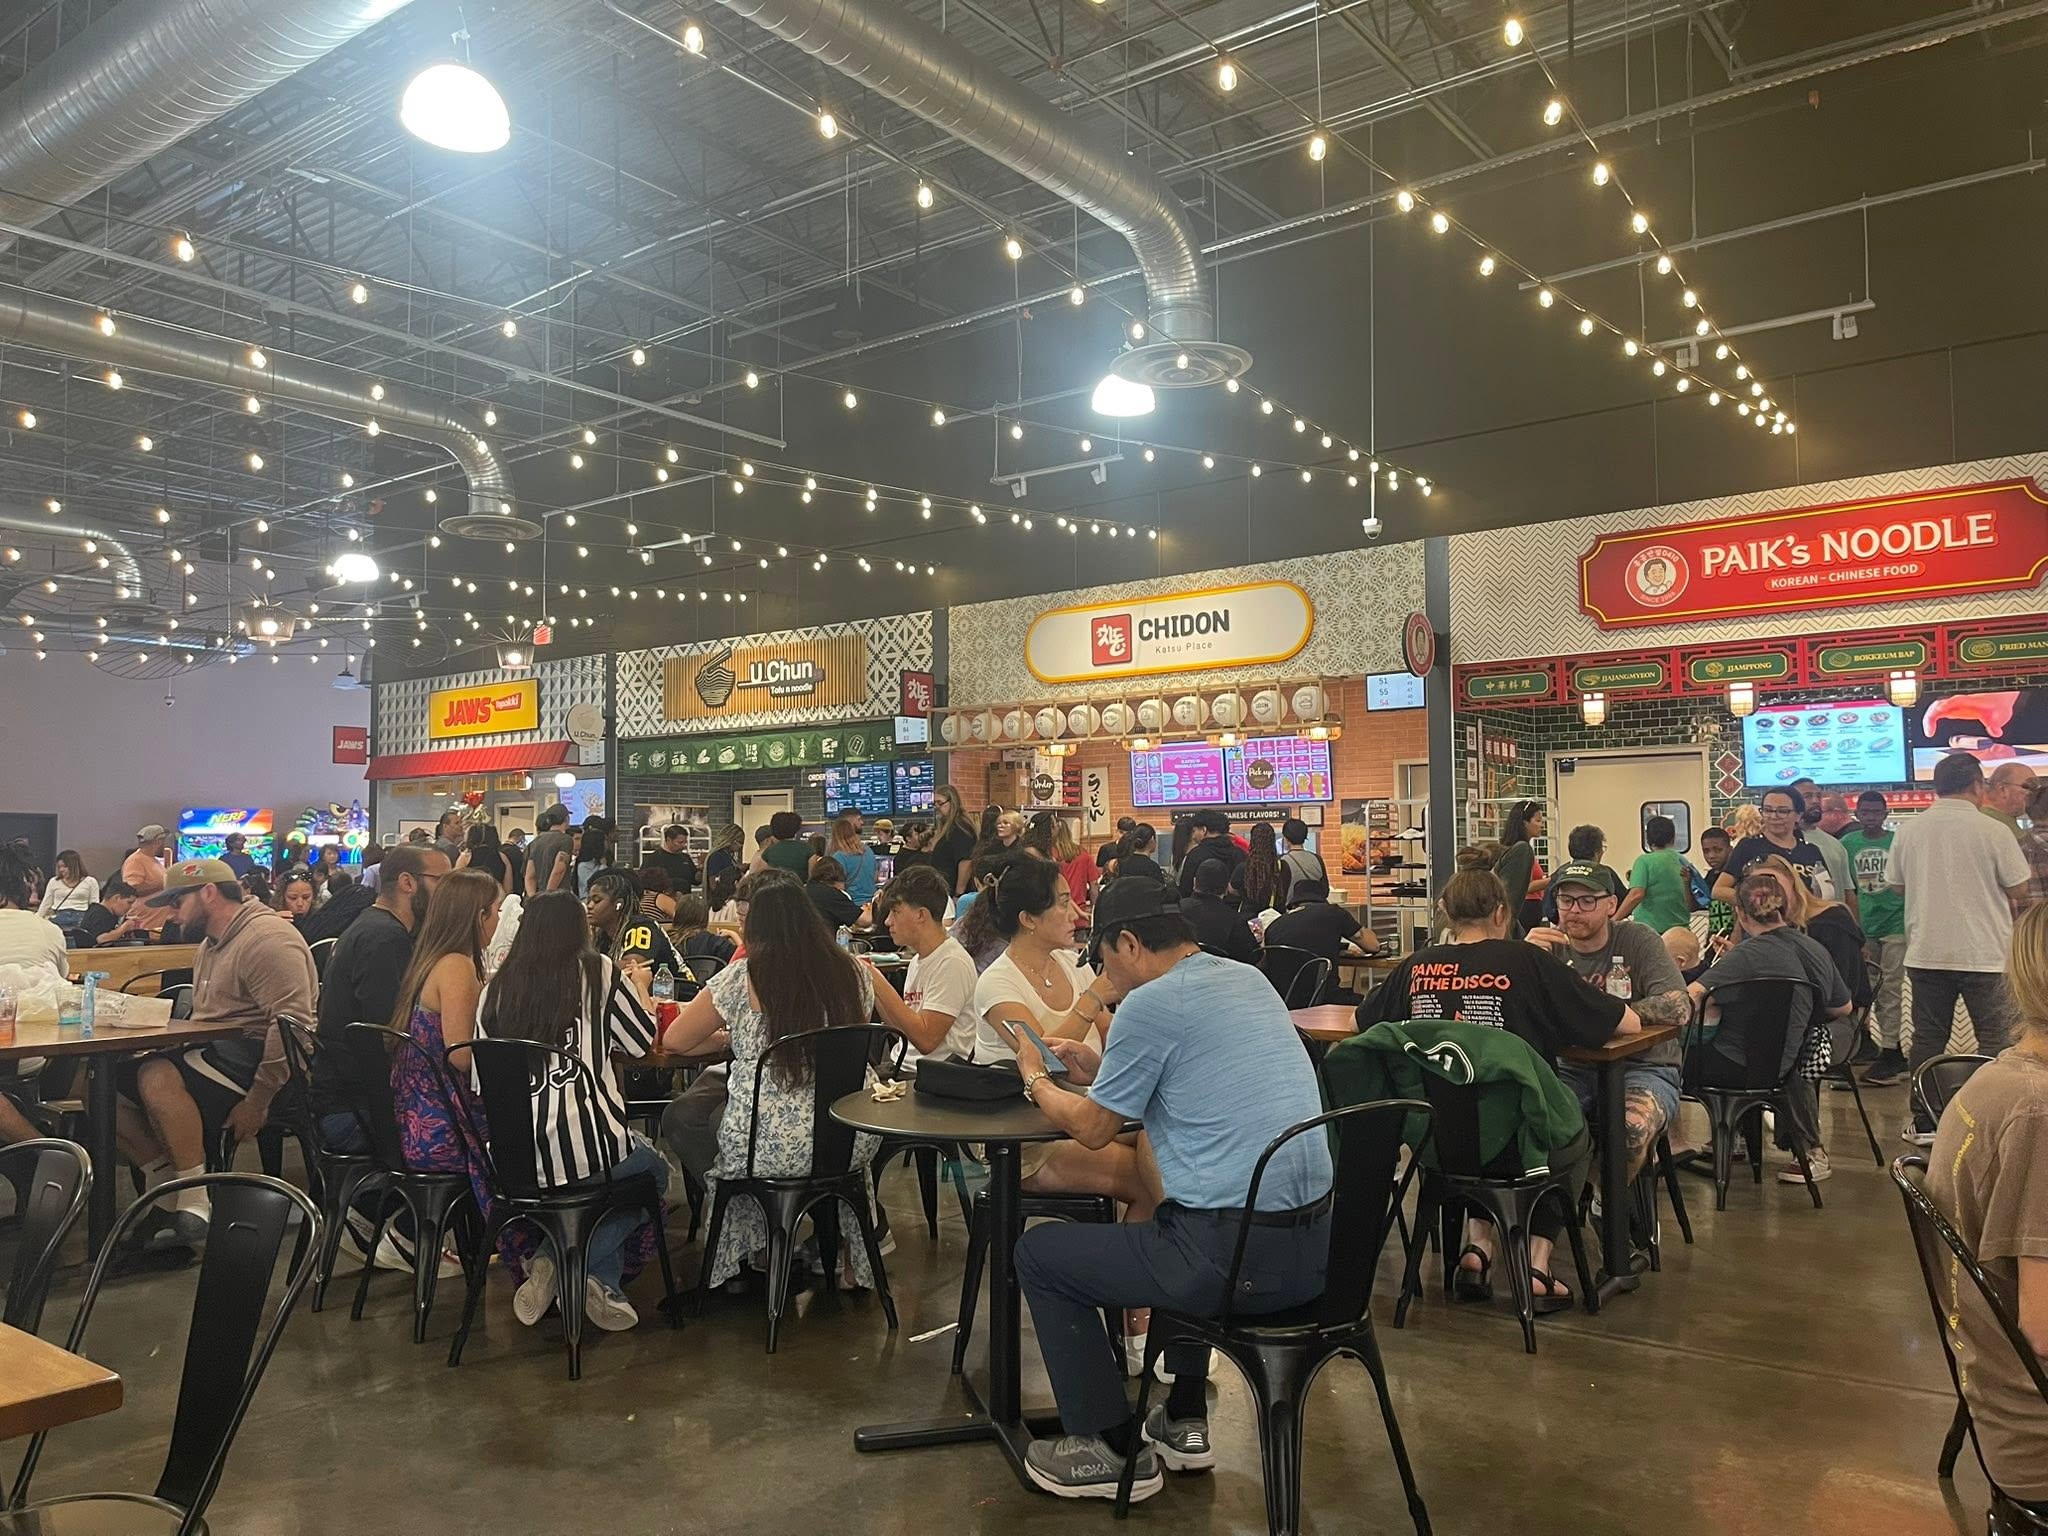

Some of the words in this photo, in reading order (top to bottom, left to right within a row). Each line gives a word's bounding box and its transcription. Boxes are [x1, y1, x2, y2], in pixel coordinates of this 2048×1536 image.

[1702, 534, 1811, 578] PAIK's
[1821, 513, 1994, 562] NOODLE
[1770, 574, 1818, 589] KOREAN
[1828, 567, 1881, 583] CHINESE
[1883, 562, 1918, 578] FOOD
[1138, 609, 1230, 641] CHIDON
[1155, 645, 1182, 654] Katsu
[1186, 641, 1213, 651] Place
[1999, 642, 2027, 651] FRIED
[1854, 652, 1898, 662] BOKKEUM
[1898, 650, 1916, 659] BAP
[1727, 661, 1772, 673] JJAMPPONG
[771, 686, 785, 694] Tofu
[791, 683, 813, 693] noodle
[443, 697, 492, 727] JAWS
[337, 740, 364, 750] JAWS
[1248, 767, 1262, 776] Pick
[1262, 770, 1273, 778] up
[1034, 780, 1053, 789] Order
[209, 810, 248, 824] NERF
[1249, 811, 1280, 819] FLAVORS!
[1411, 963, 1460, 979] PANIC!
[1422, 977, 1451, 990] THE
[1451, 973, 1511, 990] DISCO
[1952, 1132, 1976, 1177] OPPOSED
[1071, 1463, 1112, 1478] HOKA
